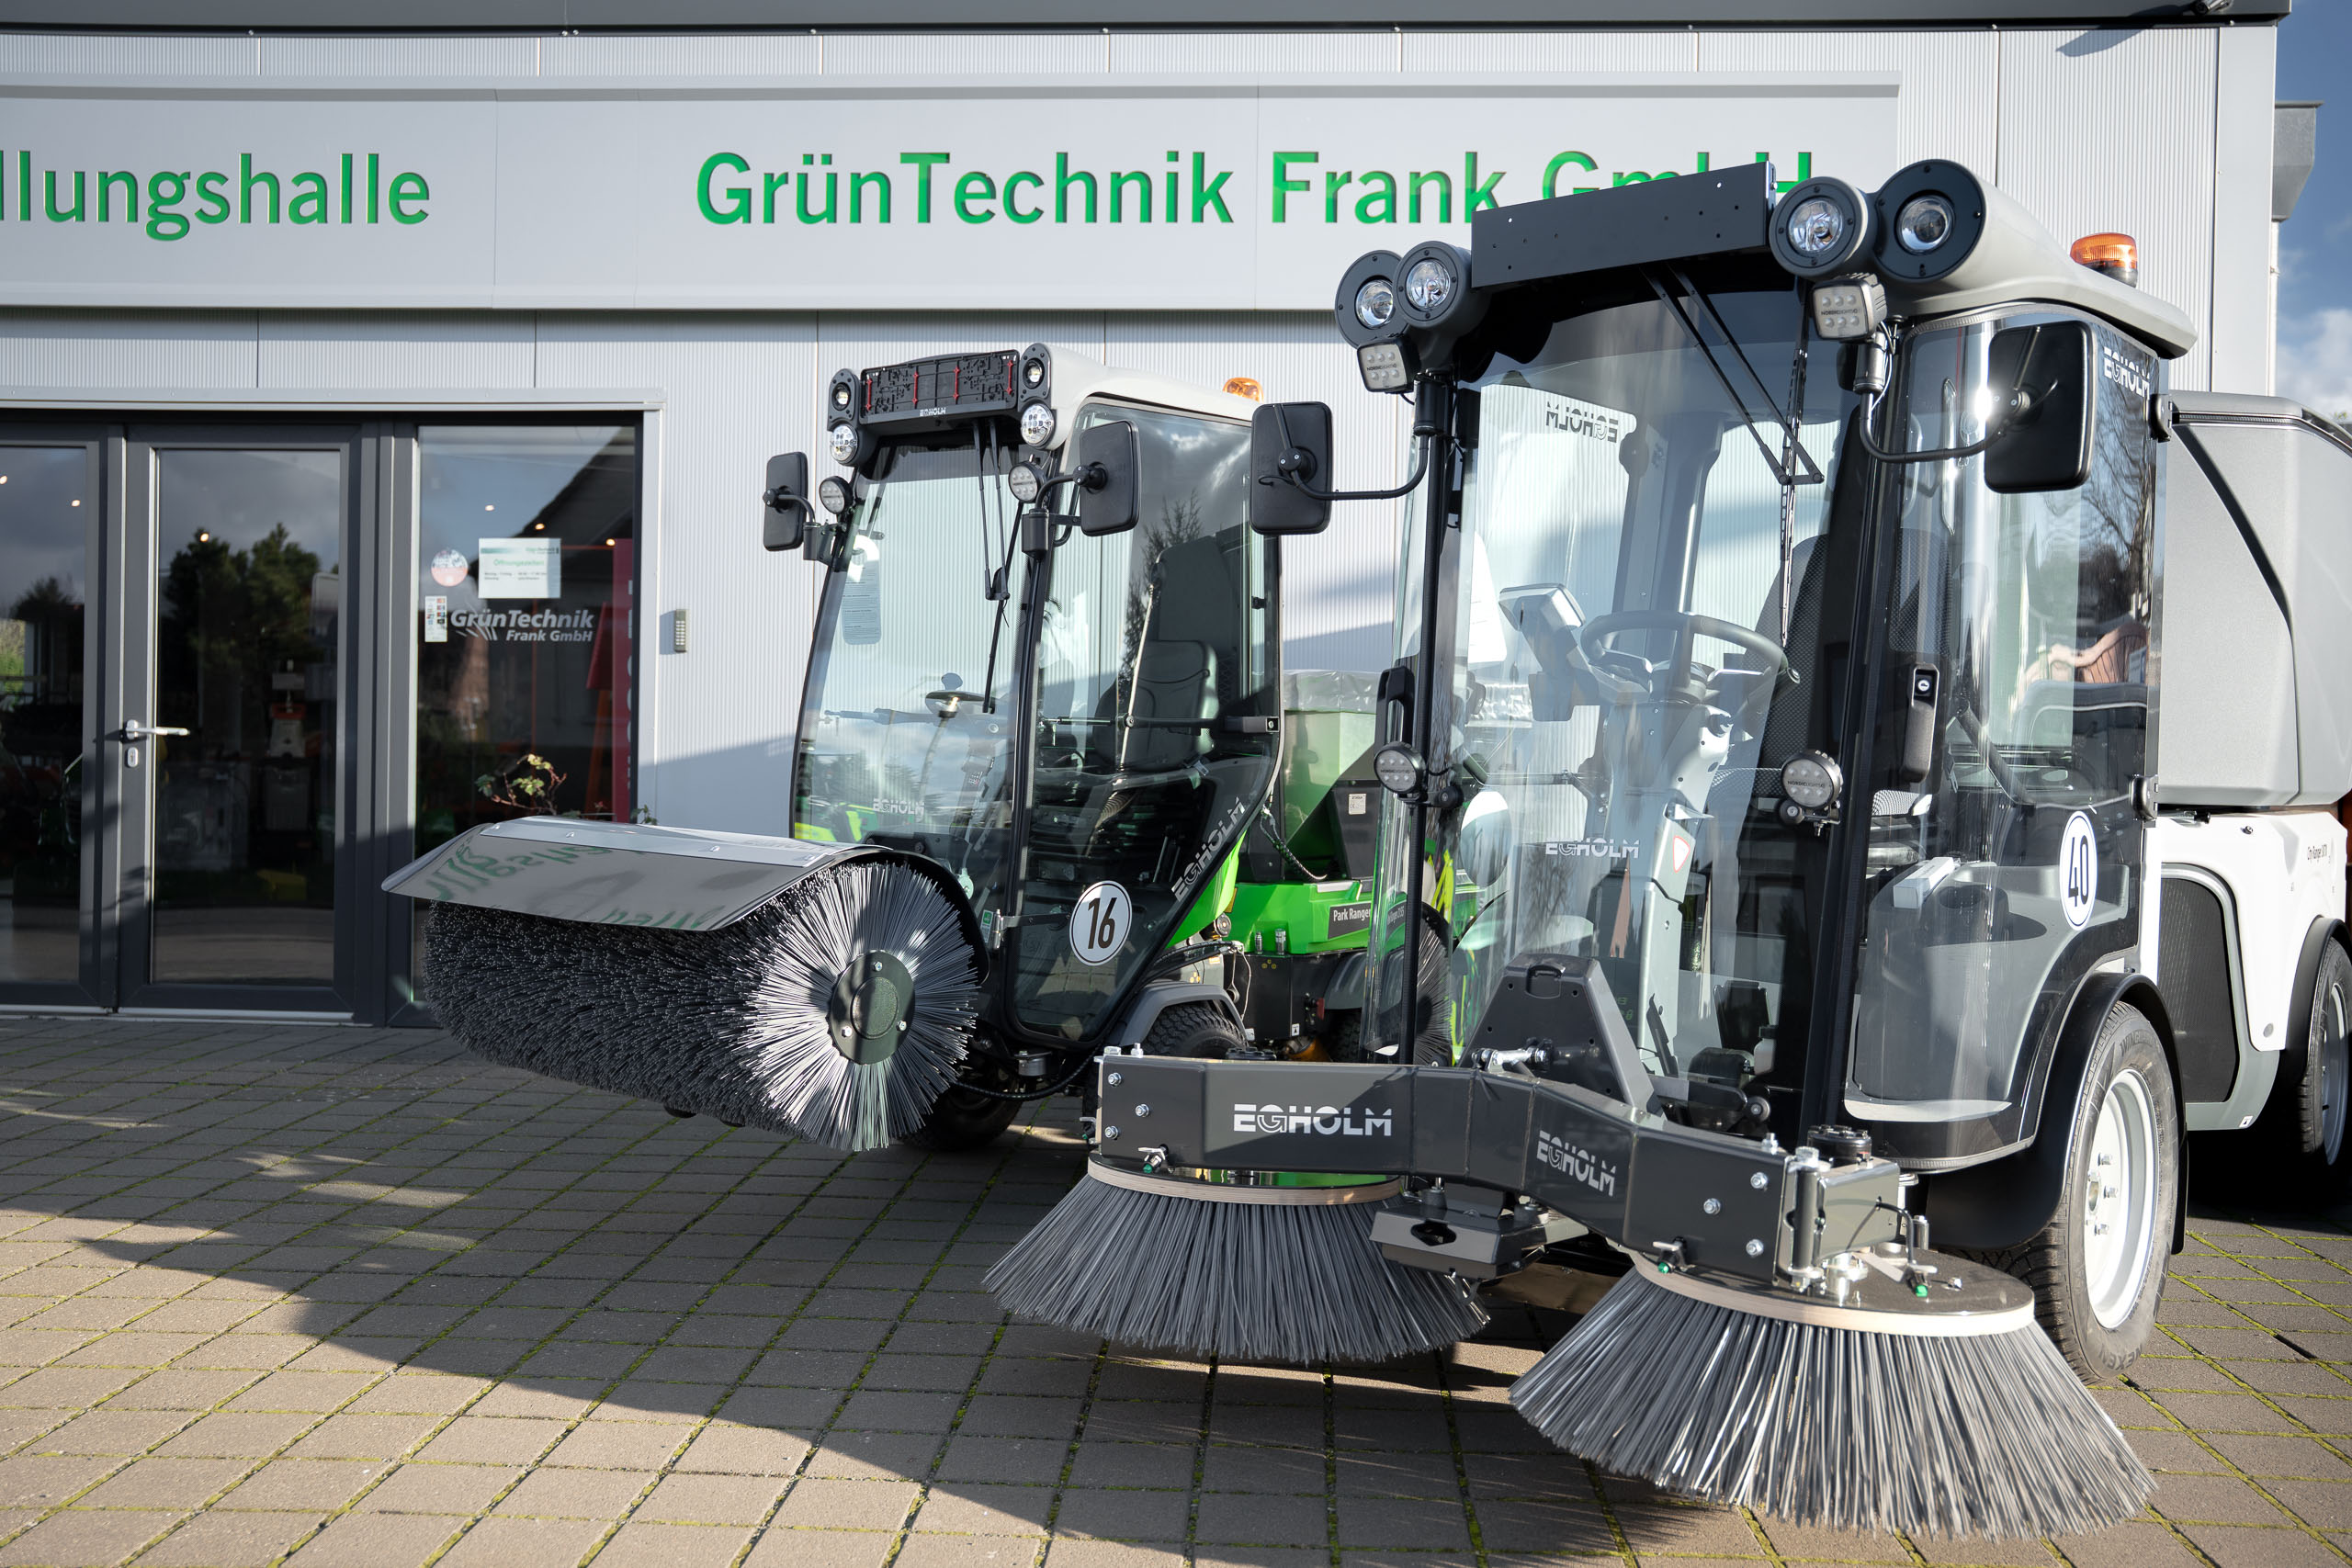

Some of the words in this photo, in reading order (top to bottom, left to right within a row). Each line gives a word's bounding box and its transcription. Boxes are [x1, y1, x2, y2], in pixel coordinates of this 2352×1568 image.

[0, 150, 430, 241] lungshalle
[696, 150, 1234, 224] GrünTechnik
[1272, 151, 1507, 224] Frank
[2104, 346, 2150, 400] EGHOLM
[920, 407, 946, 417] EGHOLM
[450, 608, 594, 628] GrünTechnik
[505, 629, 546, 641] Frank
[549, 630, 594, 642] GmbH
[873, 797, 925, 816] EGHOLM
[1171, 796, 1245, 902] EGHOLM
[1545, 838, 1640, 859] EGHOLM
[2068, 835, 2090, 908] 40
[1087, 896, 1116, 951] 16
[1333, 908, 1348, 921] Park
[1233, 1103, 1392, 1137] EGHOLM
[1536, 1130, 1617, 1197] EGHOLM
